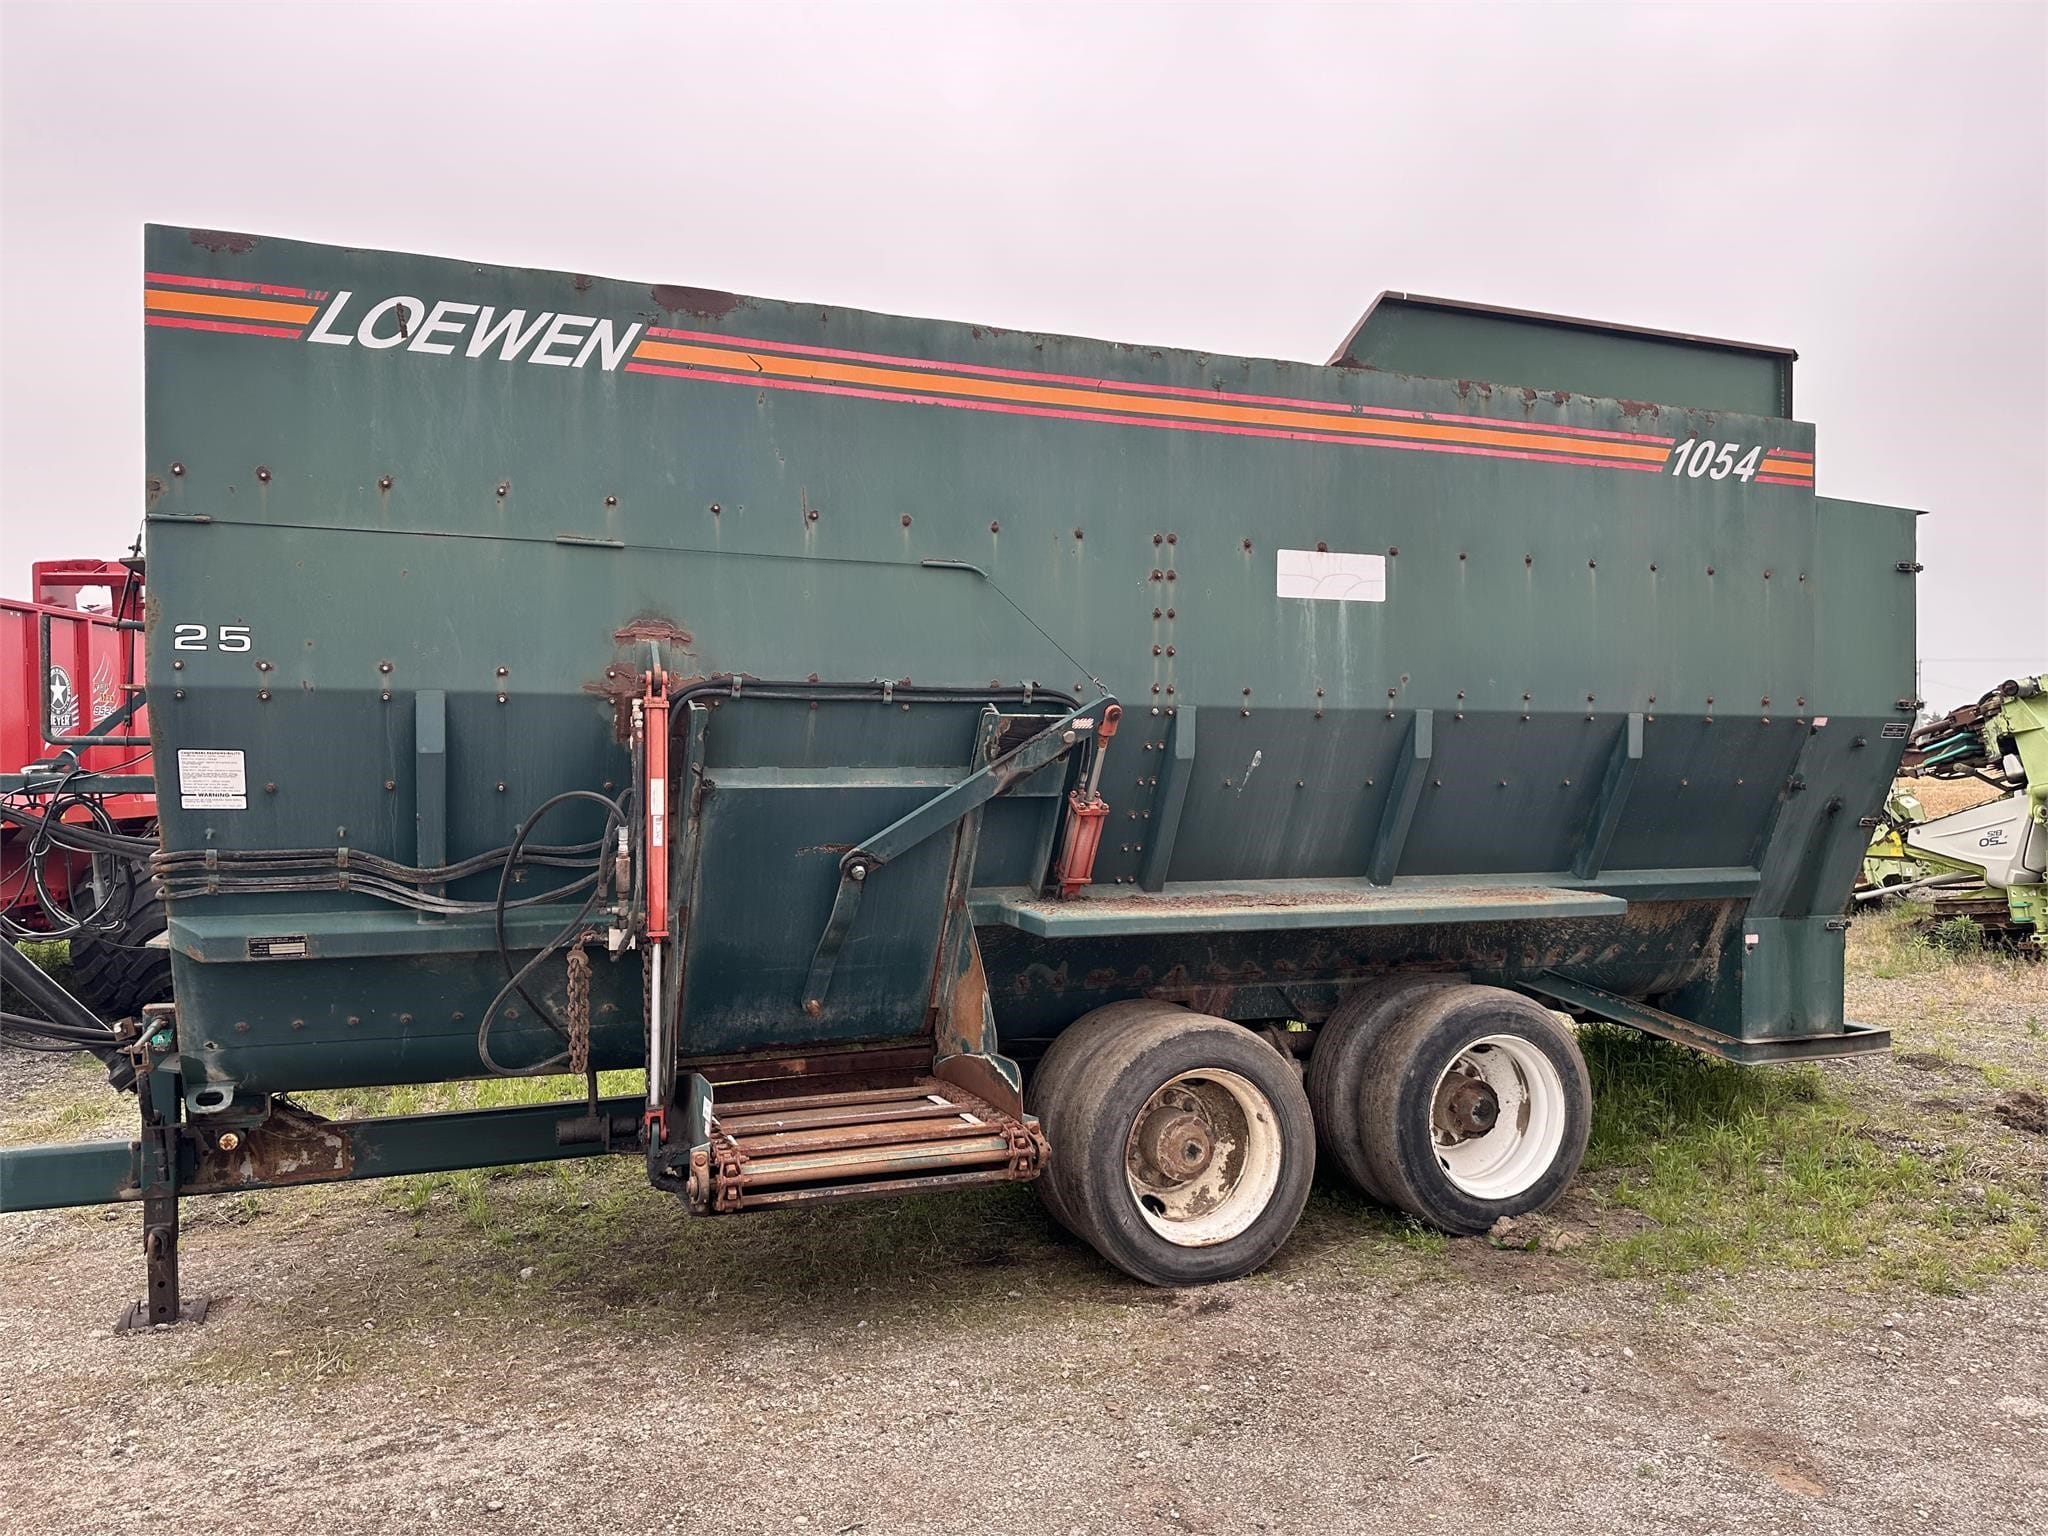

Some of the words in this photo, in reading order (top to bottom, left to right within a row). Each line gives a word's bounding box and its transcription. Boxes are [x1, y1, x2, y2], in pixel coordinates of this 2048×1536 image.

[306, 291, 643, 371] LOEWEN
[1672, 438, 1762, 483] 1054
[174, 623, 252, 652] 25
[51, 715, 71, 726] EYER
